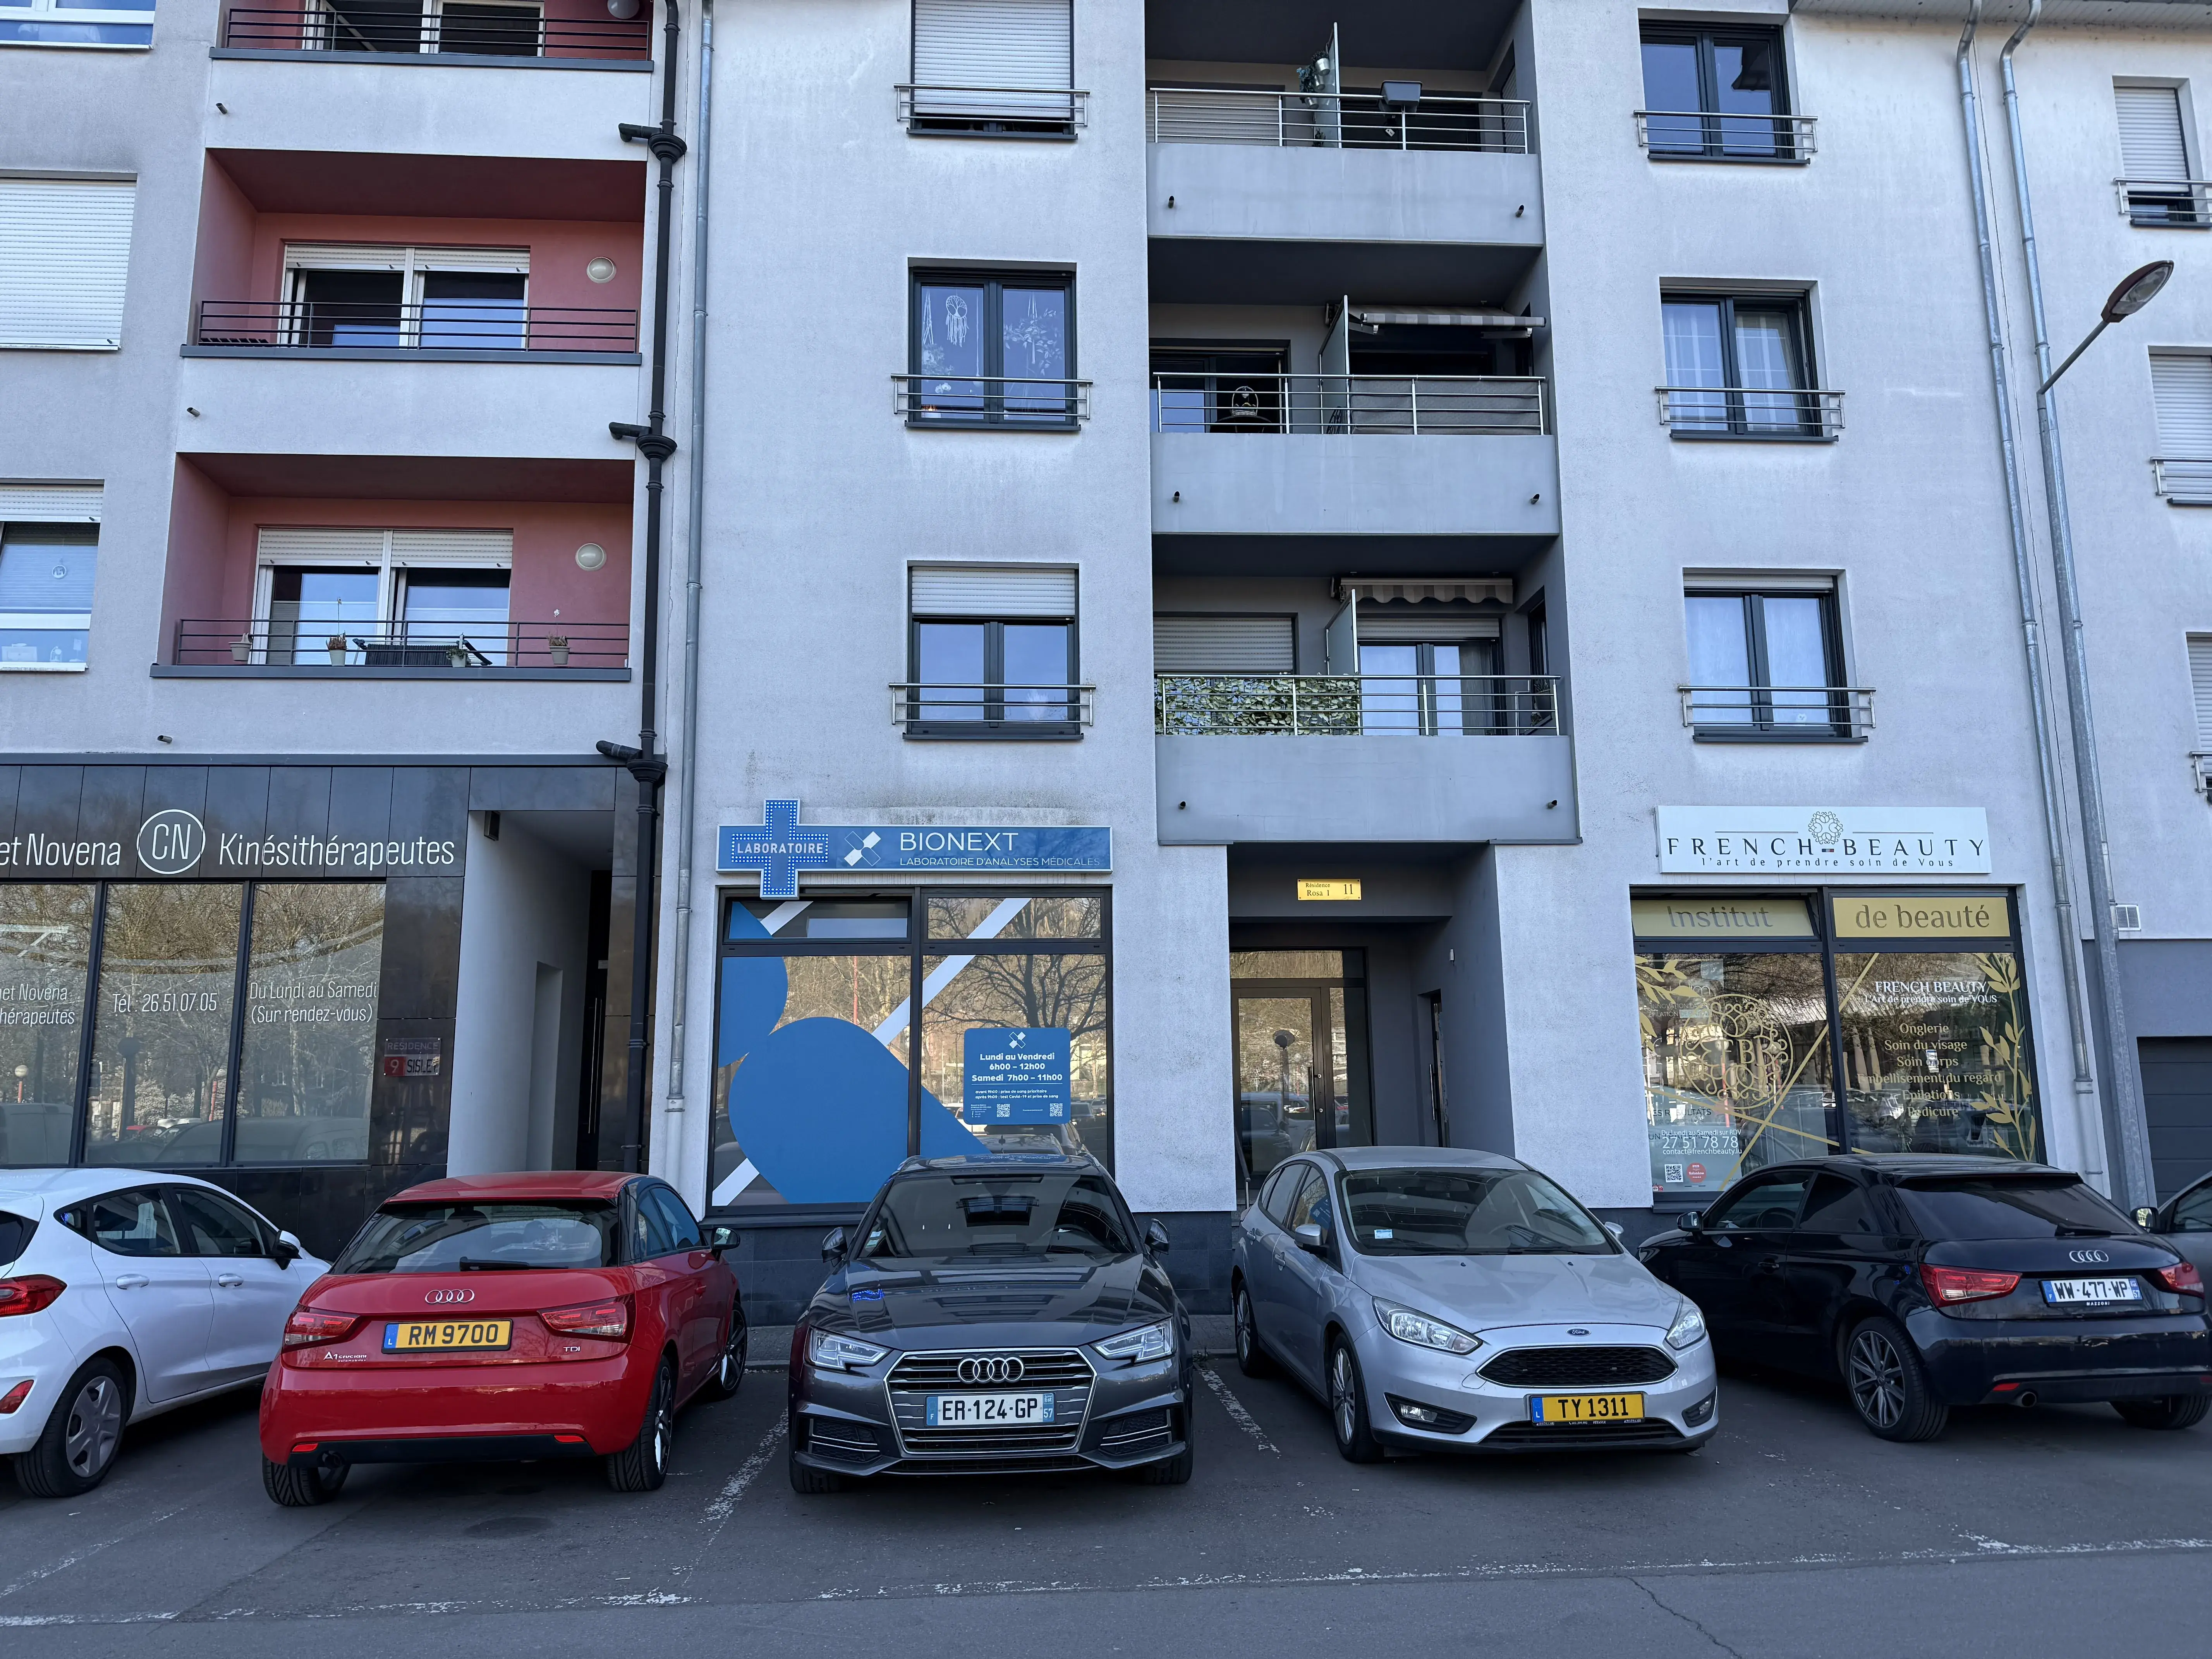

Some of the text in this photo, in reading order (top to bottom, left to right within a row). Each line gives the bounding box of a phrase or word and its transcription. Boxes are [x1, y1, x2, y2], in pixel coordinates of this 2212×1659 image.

[152, 823, 191, 860] CN
[900, 832, 1018, 851] BIONEXT
[1667, 838, 1983, 856] FRENCH BEAUTY
[26, 833, 120, 866] Novena
[219, 833, 455, 871] Kinésithérapeutes
[737, 843, 823, 854] LABORATOIRE
[900, 856, 1100, 866] LABORATOIRE D'ANALYSES MÉDICALES
[1777, 858, 1838, 867] prendre
[1850, 858, 1881, 866] soin
[1893, 858, 1907, 866] de
[1918, 858, 1953, 866] Vous
[1343, 884, 1353, 895] 11
[1667, 906, 1773, 929] Institut
[1855, 904, 1990, 928] de beauté
[0, 983, 68, 1001] et Novena
[250, 981, 377, 999] Du Lundi au Samedi
[1875, 981, 1987, 993] FRENCH BEAUTY
[112, 994, 131, 1013] Tél
[143, 993, 218, 1012] 26.51.07.05
[1887, 995, 1898, 1003] de
[1901, 995, 1936, 1005] prendre
[1938, 995, 1956, 1003] soin
[1959, 995, 1969, 1003] de
[1972, 995, 1997, 1003] VOUS
[0, 1008, 75, 1027] hérapeutes
[252, 1003, 372, 1024] (Sur rendez-vous)
[1900, 1023, 1949, 1036] Onglerie
[387, 1041, 439, 1050] RESIDENCE
[1884, 1040, 1967, 1052] Soin du visage
[980, 1053, 1003, 1061] Lundi
[1017, 1052, 1055, 1060] Vendredi
[1897, 1057, 1923, 1066] Soin
[390, 1059, 399, 1073] 9
[1946, 1073, 1961, 1083] du
[1963, 1073, 2001, 1085] regard
[1662, 1137, 1677, 1149] 27
[1683, 1137, 1696, 1148] 51
[1704, 1136, 1719, 1148] 78
[1722, 1136, 1739, 1148] 78
[2132, 1290, 2140, 1298] 57
[409, 1324, 498, 1345] RM 9700
[323, 1351, 338, 1360] A1
[1044, 1408, 1053, 1418] 57
[1558, 1397, 1629, 1418] TY 1311
